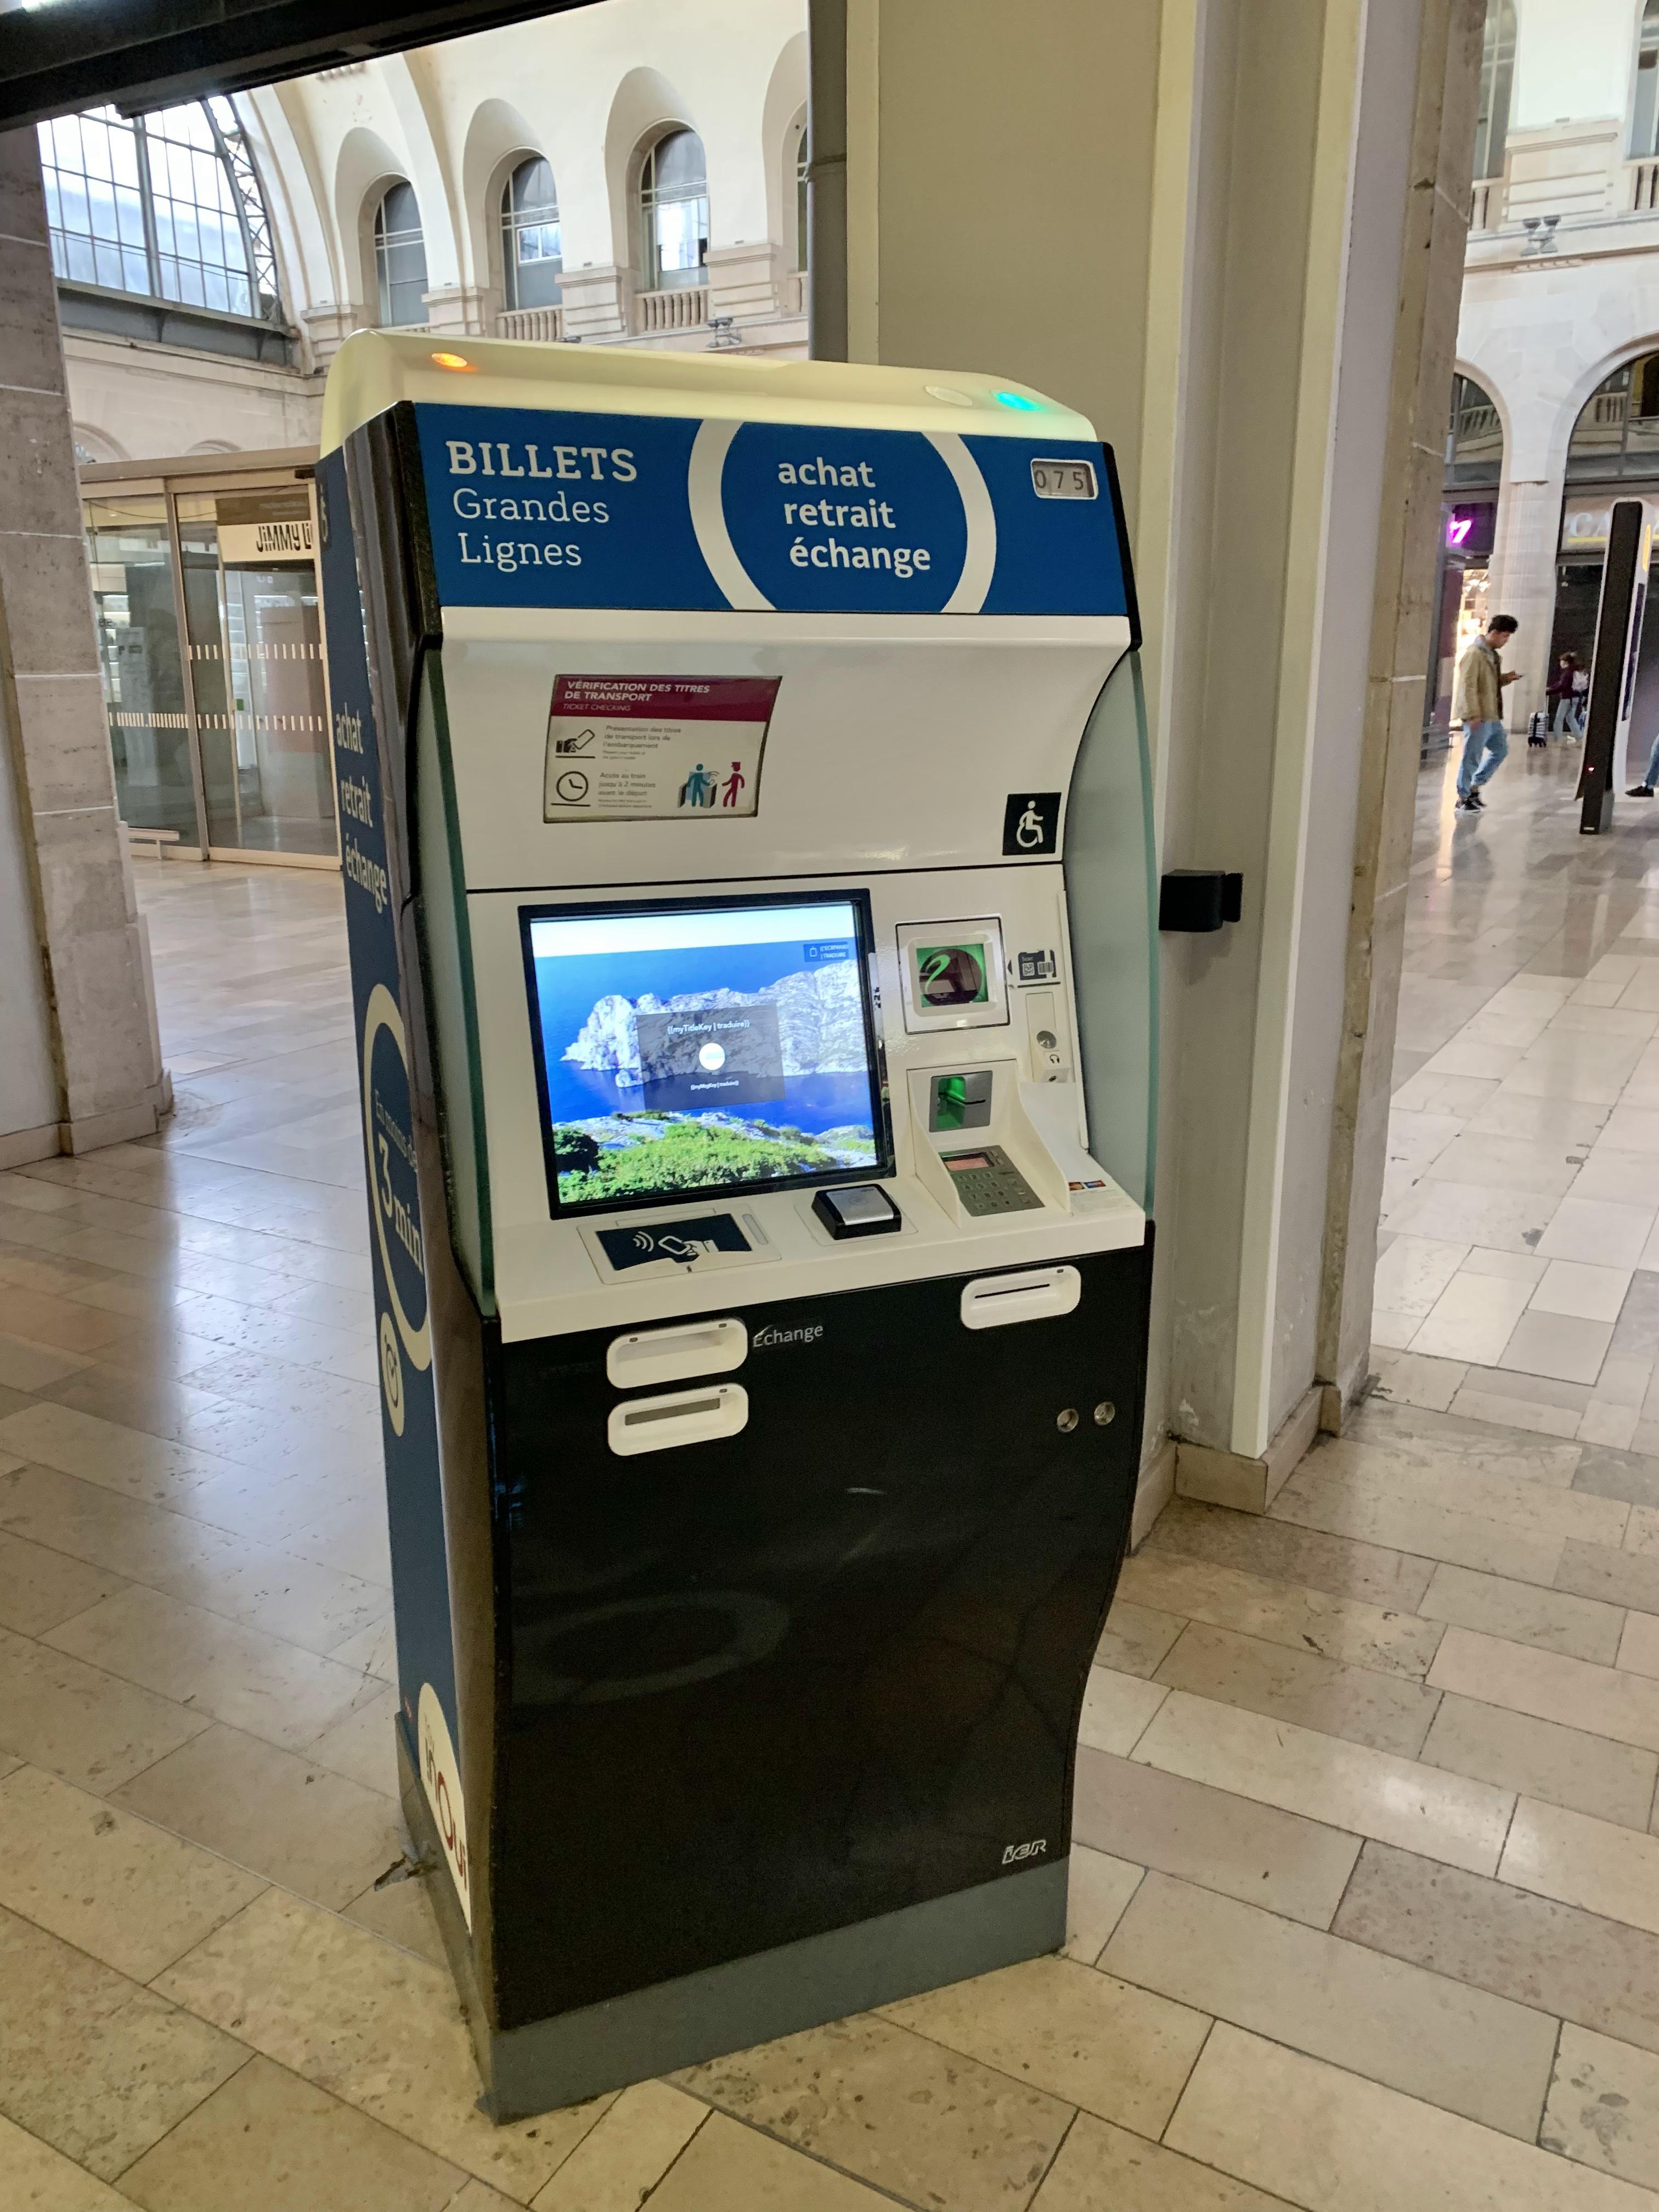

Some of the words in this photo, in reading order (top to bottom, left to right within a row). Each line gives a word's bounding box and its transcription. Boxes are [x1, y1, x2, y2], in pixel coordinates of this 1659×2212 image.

[445, 441, 637, 482] BILLETS
[777, 456, 876, 488] achat
[1034, 470, 1084, 490] 075
[453, 488, 609, 523] Grandes
[784, 499, 896, 528] retrait
[458, 532, 582, 572] Lignes
[789, 537, 930, 578] échange
[567, 680, 646, 691] VÉRIFICATION
[650, 684, 672, 692] DES
[675, 685, 710, 693] TITRES
[584, 692, 652, 701] TRANSPORT
[335, 703, 363, 754] achat
[341, 775, 374, 827] retrait
[345, 834, 387, 913] échange
[378, 1131, 393, 1218] 3
[394, 1194, 424, 1275] min
